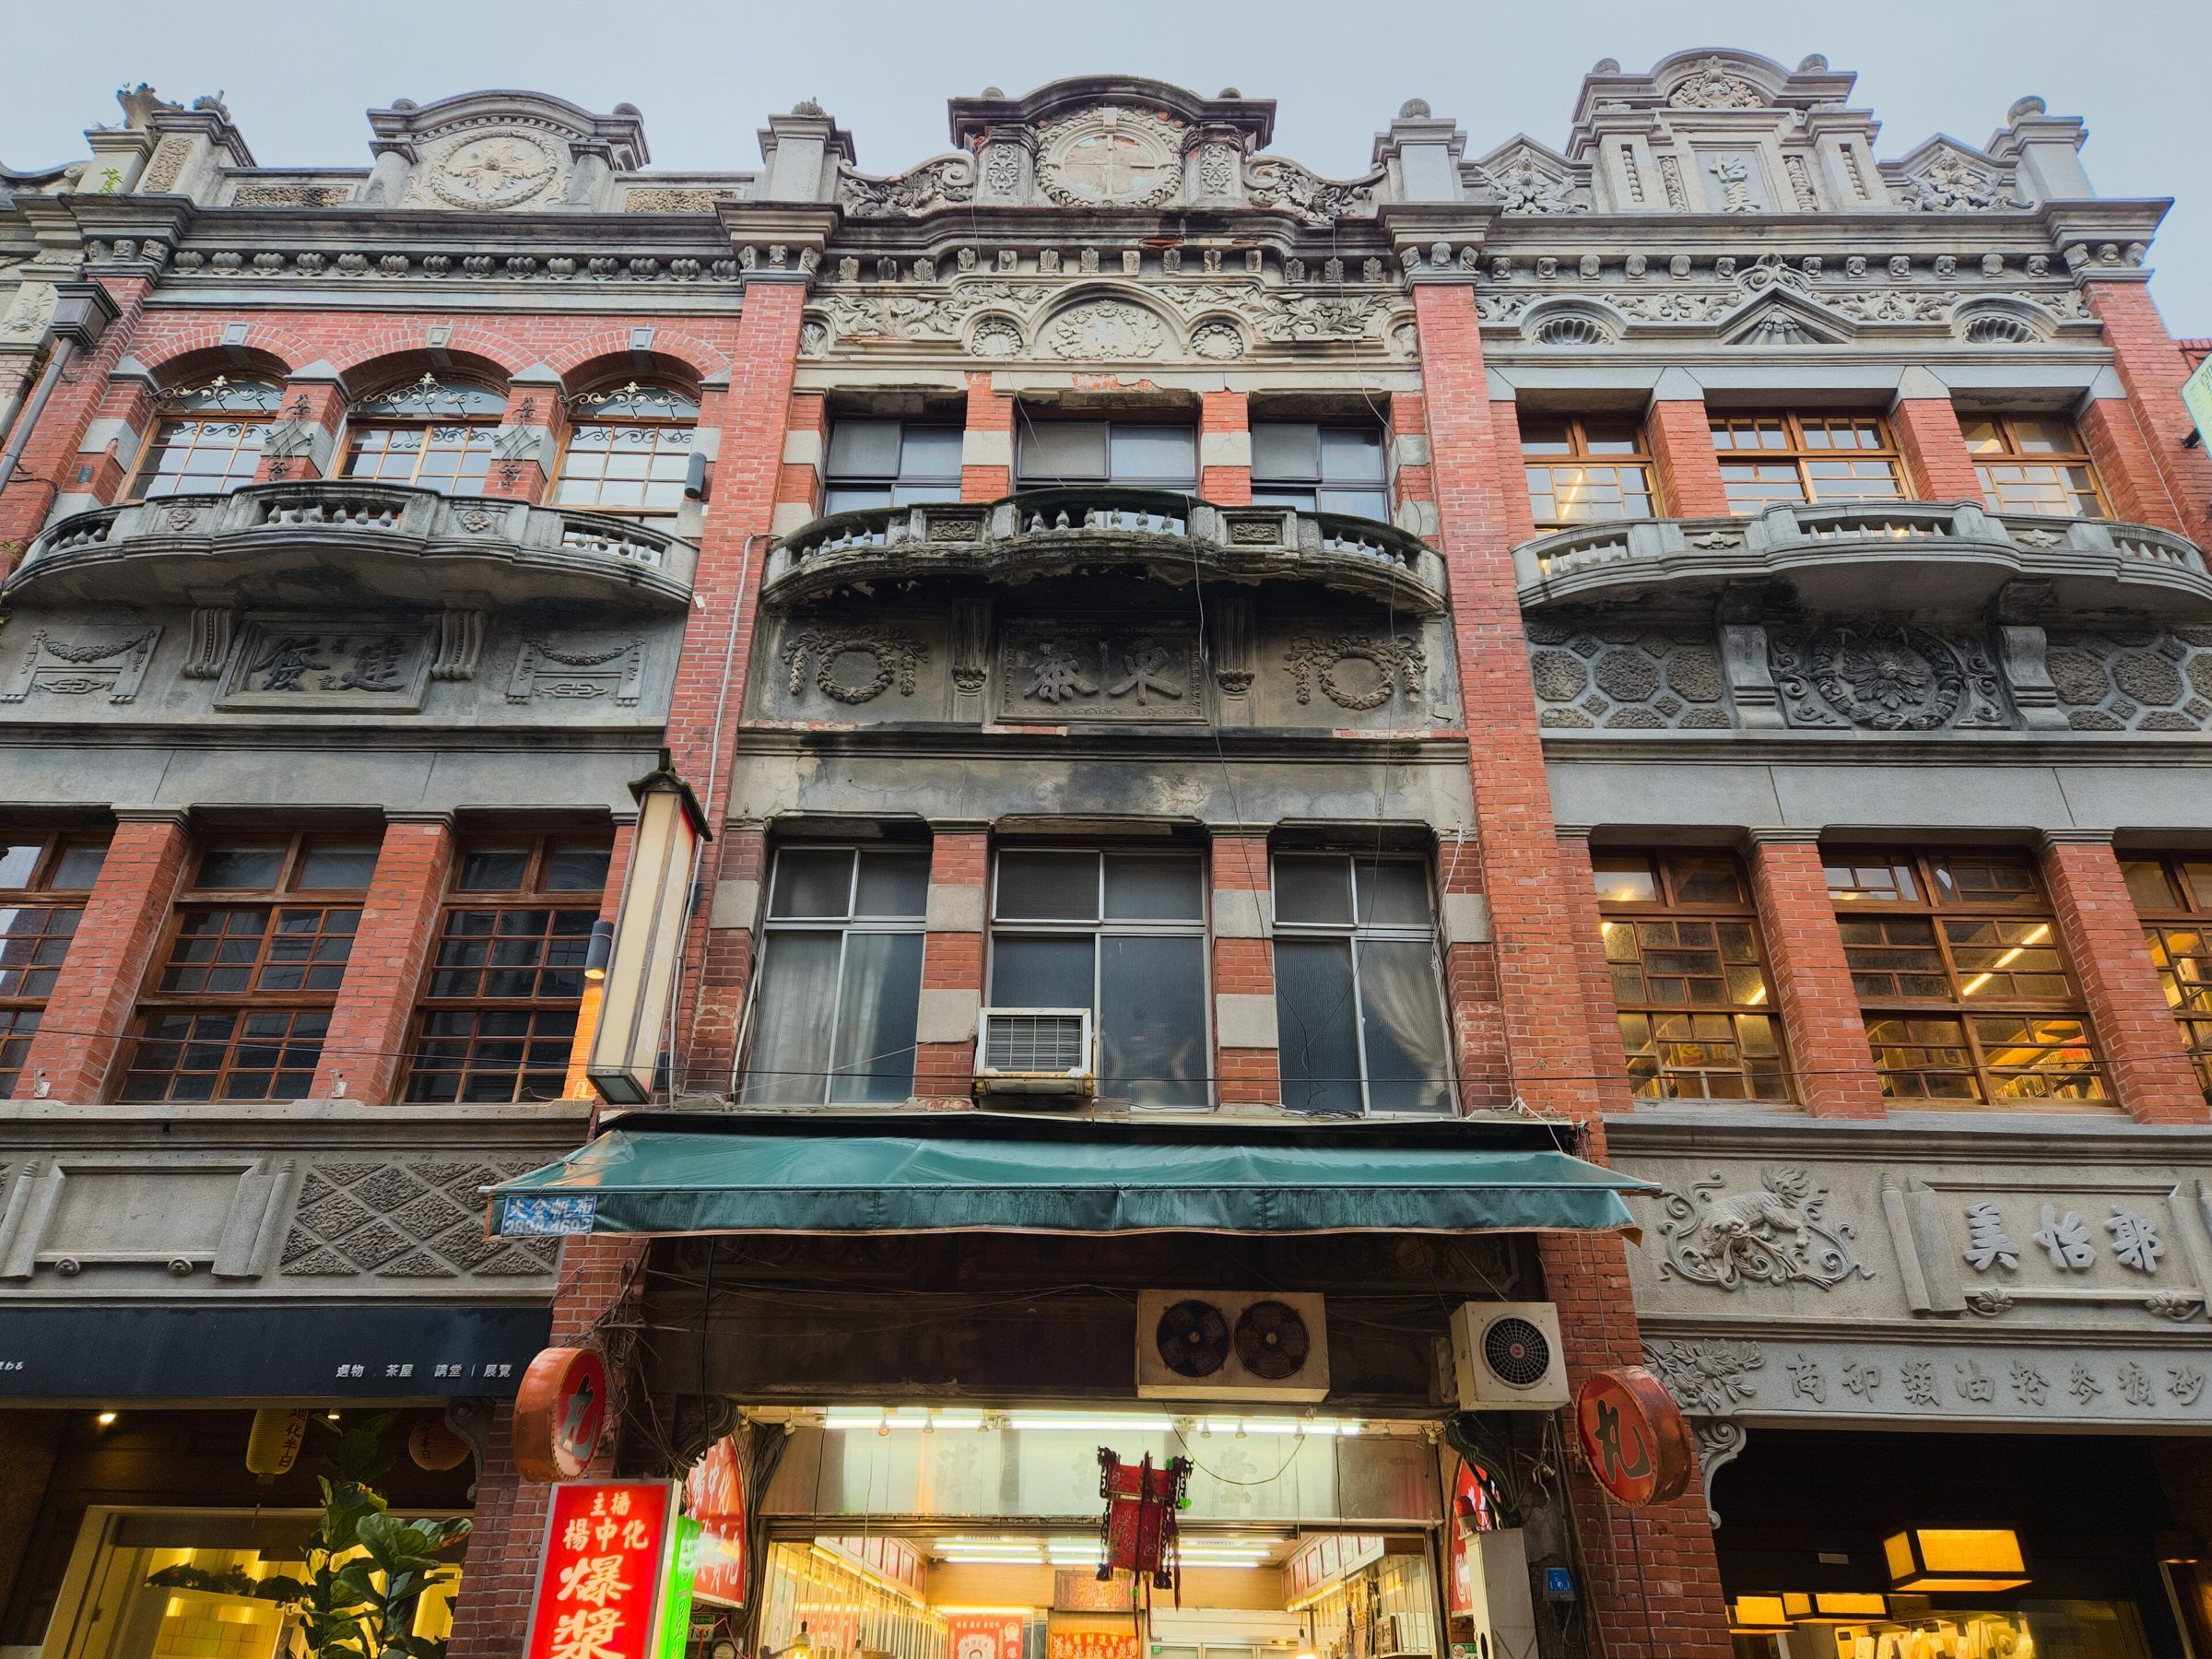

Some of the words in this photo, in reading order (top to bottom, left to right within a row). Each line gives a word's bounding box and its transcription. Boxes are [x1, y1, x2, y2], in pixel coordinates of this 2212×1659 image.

[1710, 153, 1761, 214] 怡美
[335, 1364, 365, 1378] 選物
[385, 1364, 415, 1378] 茶屋
[434, 1364, 463, 1378] 講堂
[483, 1364, 512, 1378] 展覽
[590, 1490, 631, 1517] 主播
[562, 1518, 649, 1552] 楊中化
